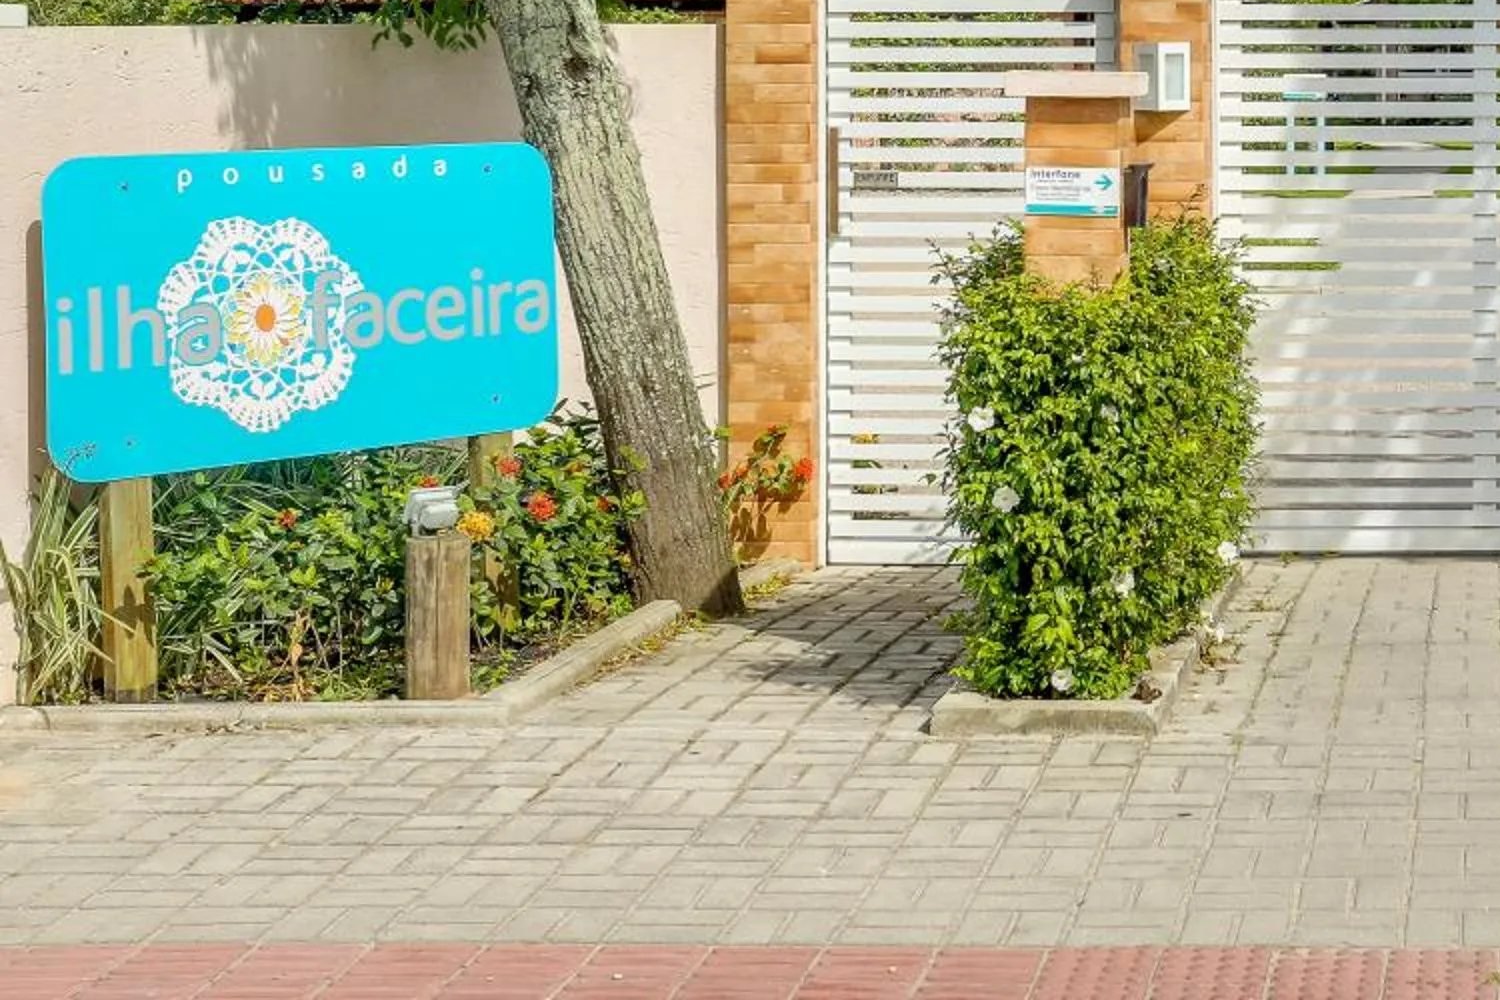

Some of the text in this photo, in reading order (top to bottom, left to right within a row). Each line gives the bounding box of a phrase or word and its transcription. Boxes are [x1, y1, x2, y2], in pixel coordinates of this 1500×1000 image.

[176, 154, 447, 193] pousada
[56, 267, 550, 375] ilha faceira
